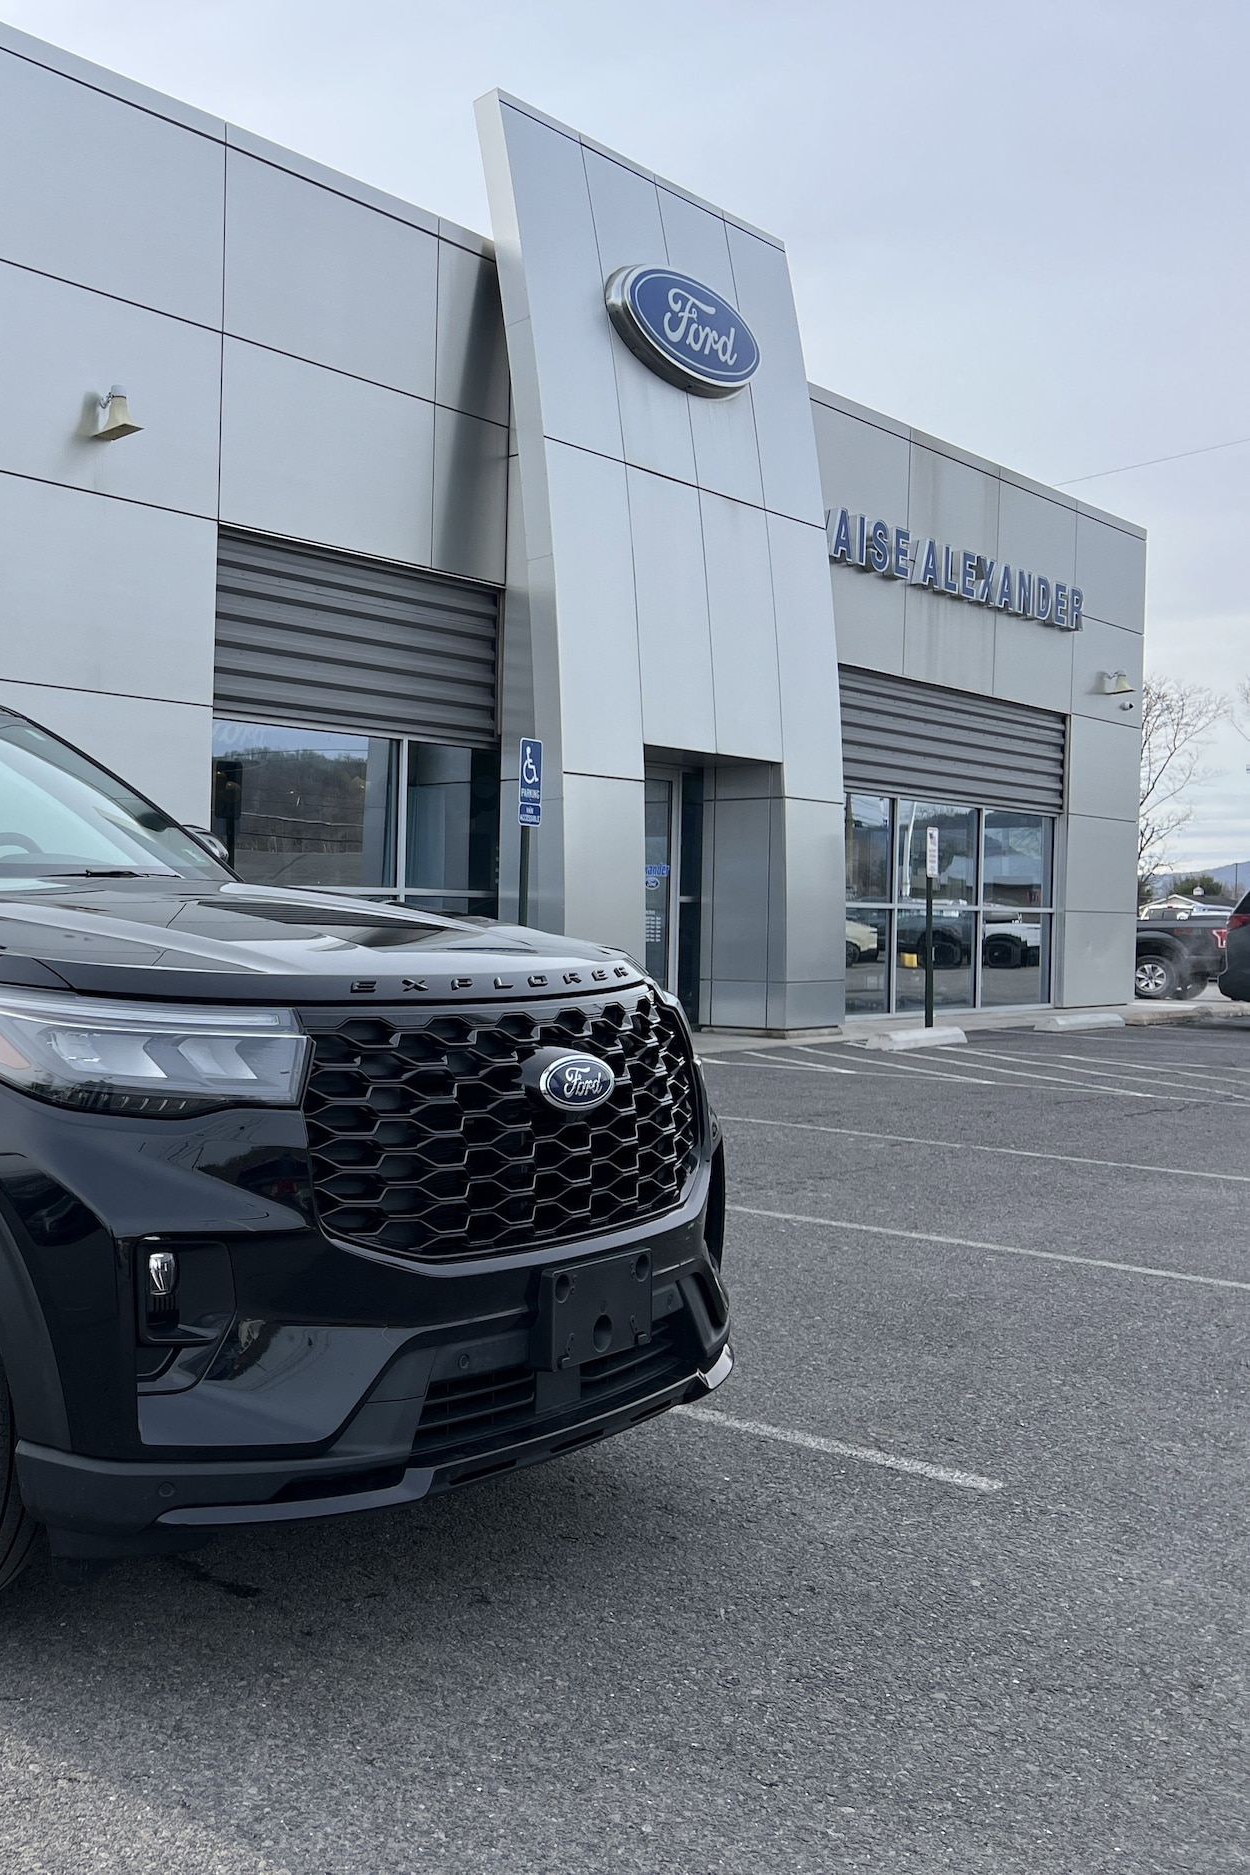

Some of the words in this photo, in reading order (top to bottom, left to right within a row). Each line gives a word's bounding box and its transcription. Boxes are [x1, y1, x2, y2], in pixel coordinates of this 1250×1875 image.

[663, 288, 738, 366] Ford
[918, 537, 1084, 631] ALEXANDER
[521, 788, 540, 799] PARKING
[349, 965, 630, 994] EXPLORER
[563, 1066, 603, 1098] Ford
